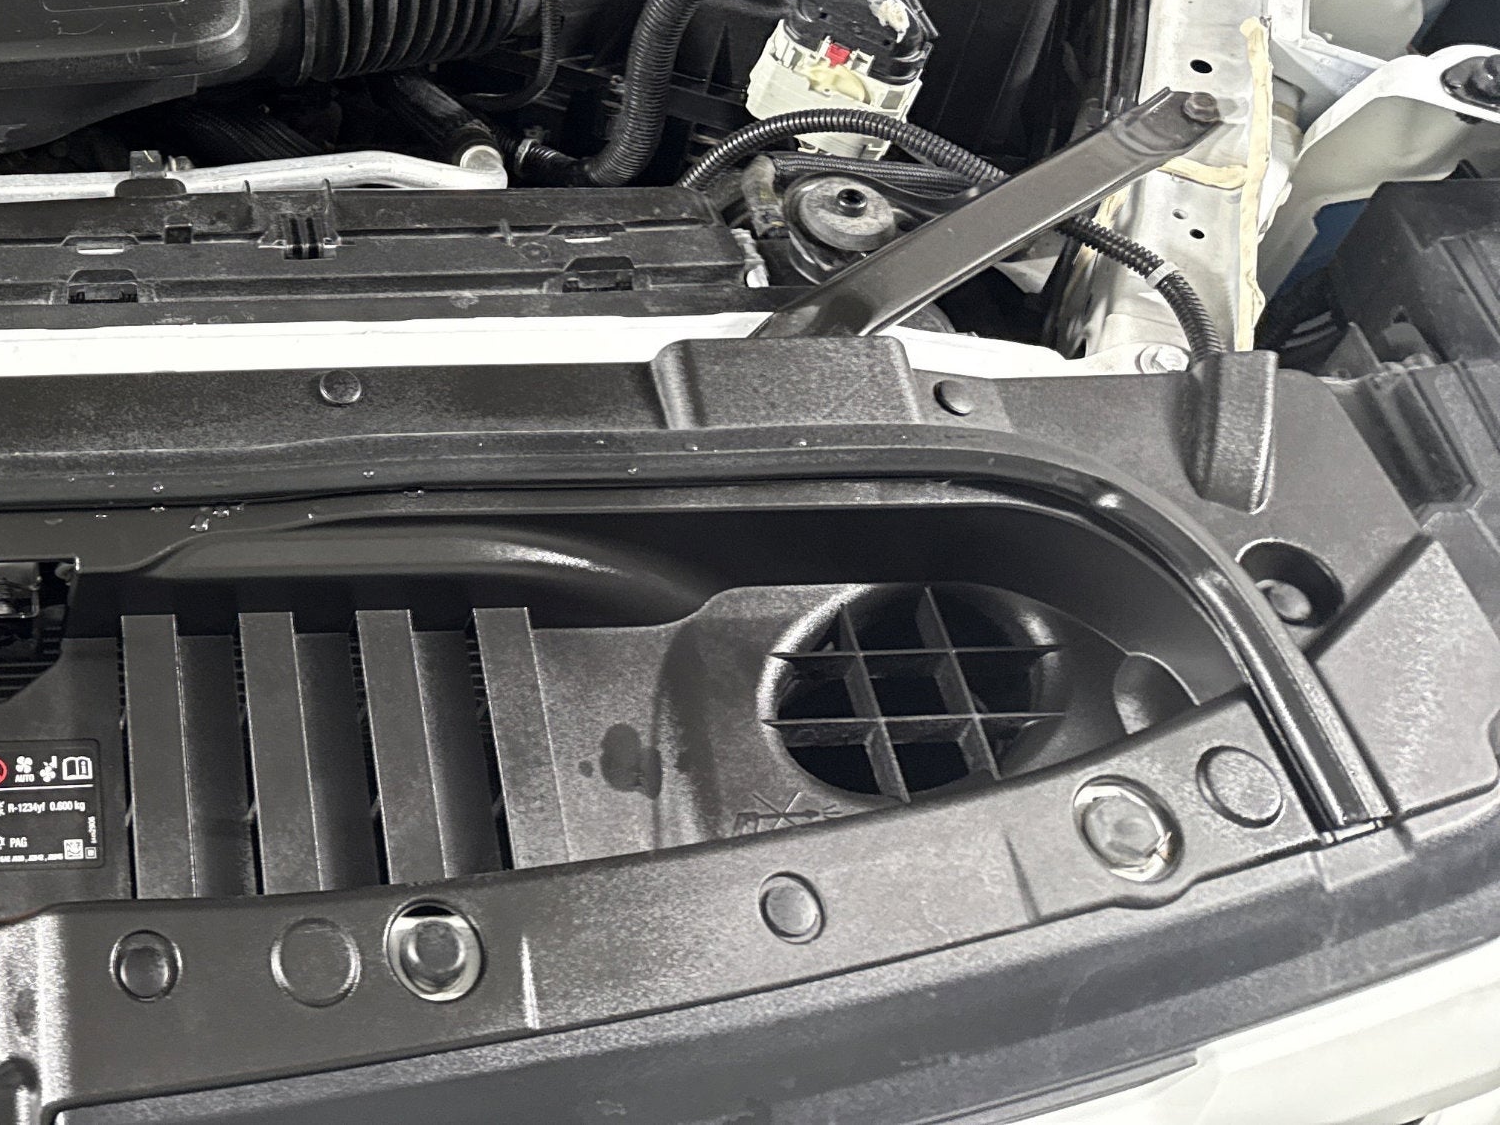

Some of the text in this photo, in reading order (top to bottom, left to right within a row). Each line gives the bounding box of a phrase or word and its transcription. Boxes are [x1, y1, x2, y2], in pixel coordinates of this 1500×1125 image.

[15, 774, 35, 783] AUTO
[7, 801, 46, 814] R-1234yf
[73, 800, 86, 812] kg
[9, 836, 28, 848] PAG
